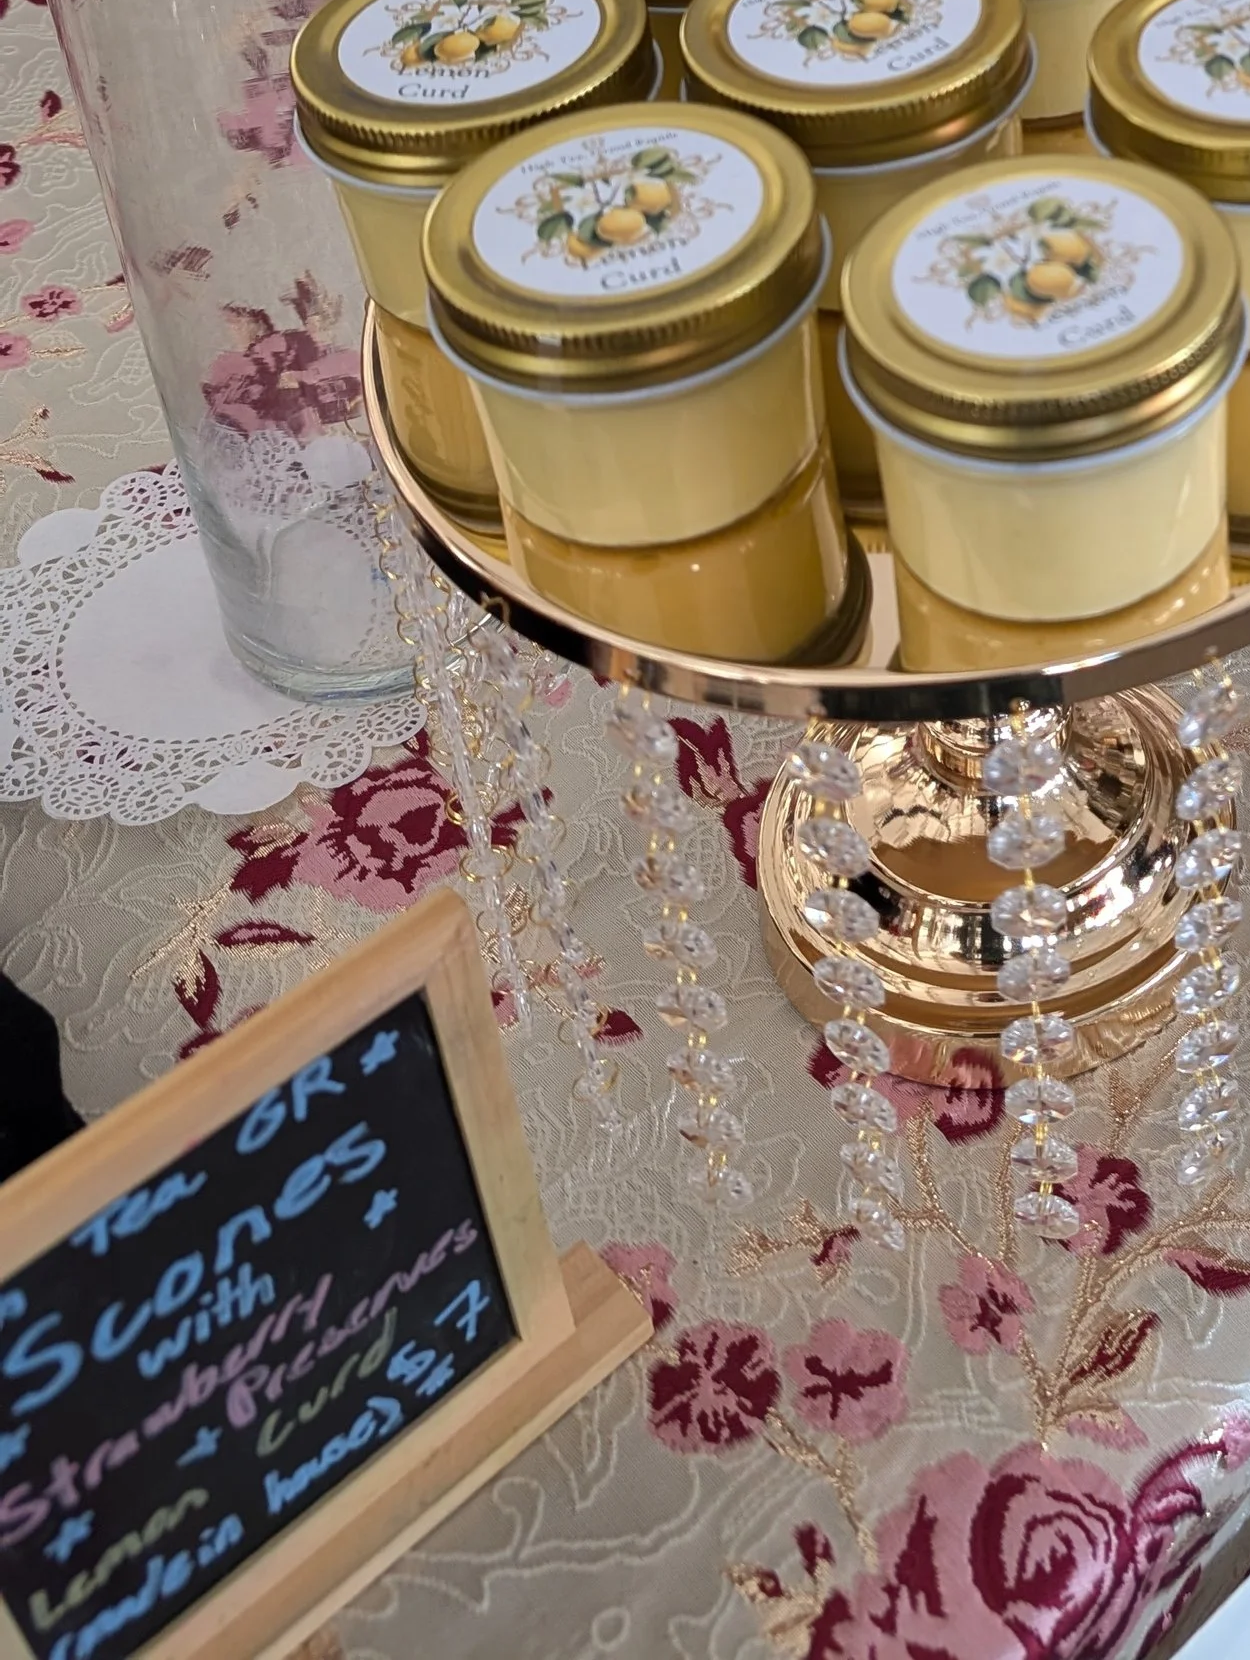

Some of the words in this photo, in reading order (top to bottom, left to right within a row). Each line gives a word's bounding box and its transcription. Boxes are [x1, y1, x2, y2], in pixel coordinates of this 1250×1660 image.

[397, 65, 491, 82] Lemon
[397, 82, 470, 100] Curd
[886, 36, 951, 73] Curd
[600, 254, 683, 291] Curd
[1056, 303, 1137, 350] Curd
[2, 1120, 388, 1417] Scones
[137, 1261, 277, 1380] with
[225, 1217, 479, 1429] Preserves
[0, 1272, 333, 1546] Strawberry
[27, 1487, 210, 1633] Lemon
[255, 1305, 398, 1458] Curd
